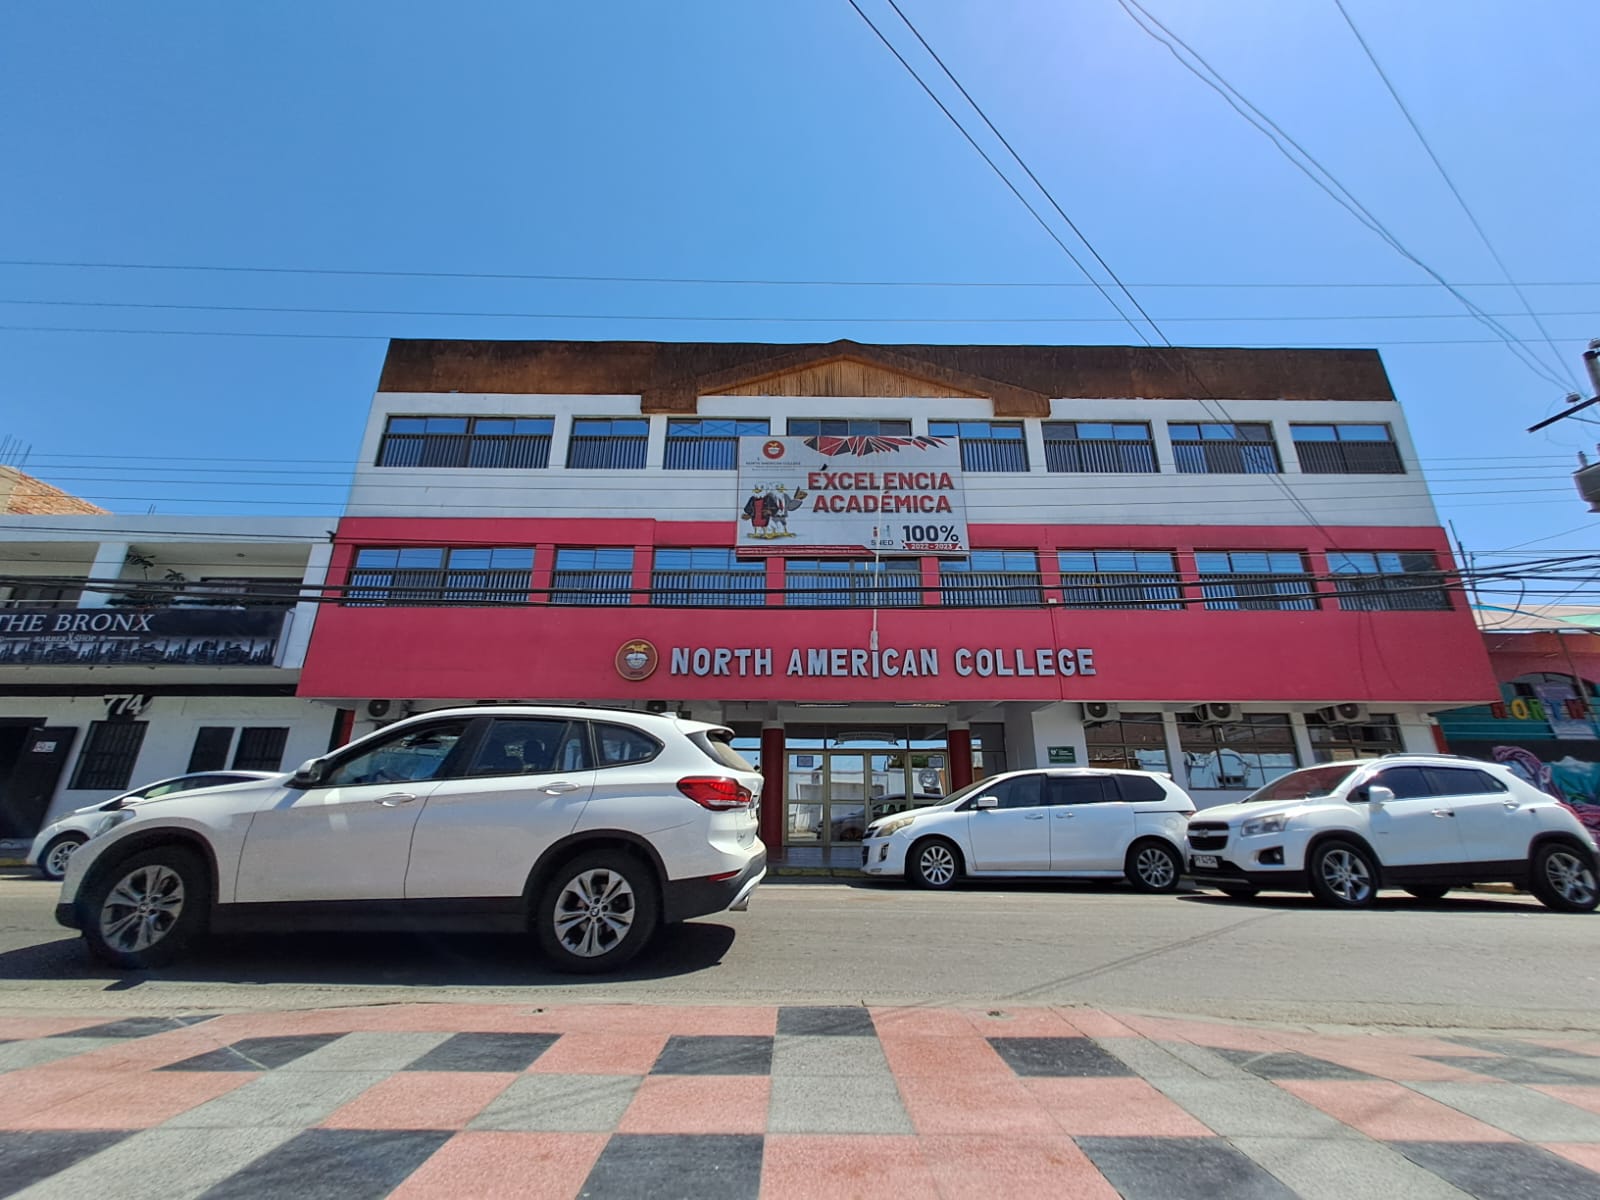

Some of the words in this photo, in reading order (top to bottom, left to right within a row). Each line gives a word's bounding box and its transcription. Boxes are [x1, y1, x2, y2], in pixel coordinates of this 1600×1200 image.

[813, 491, 952, 513] ACADÉMICA
[902, 525, 959, 542] 100%
[52, 613, 155, 632] BRONX
[671, 647, 773, 677] NORTH
[786, 647, 940, 678] AMERICAN
[955, 647, 1097, 677] COLLEGE
[103, 694, 144, 715] 774
